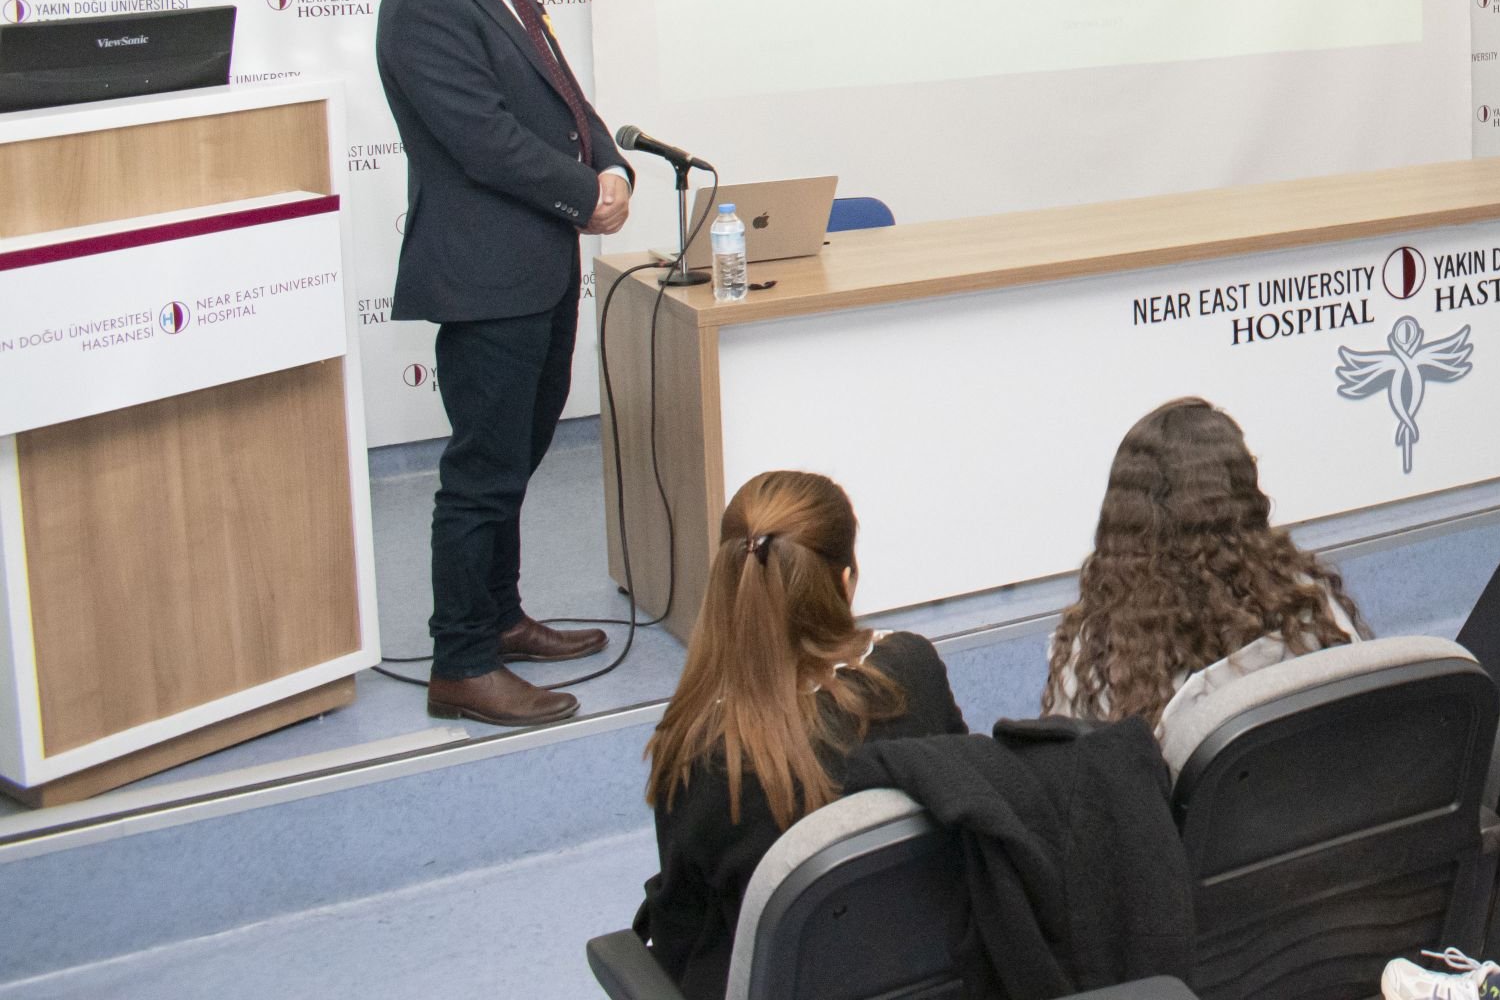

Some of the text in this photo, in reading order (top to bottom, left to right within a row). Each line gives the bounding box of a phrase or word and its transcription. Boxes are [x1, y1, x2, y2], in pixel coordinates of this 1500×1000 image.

[35, 2, 69, 14] YAKIN
[74, 0, 106, 12] DOĞU
[298, 3, 372, 17] HOSPITAL
[97, 34, 149, 49] ViewSonic
[1433, 249, 1485, 279] YAKIN
[196, 272, 337, 309] NEAR EAST UNIVERSITY
[1133, 265, 1374, 325] NEAR EAST UNIVERSITY
[19, 329, 62, 348] DOĞU
[69, 308, 152, 337] ÜNİVERSİTESİ
[197, 304, 255, 325] HOSPITAL
[1232, 299, 1374, 344] HOSPITAL
[82, 327, 153, 351] HASTANESİ
